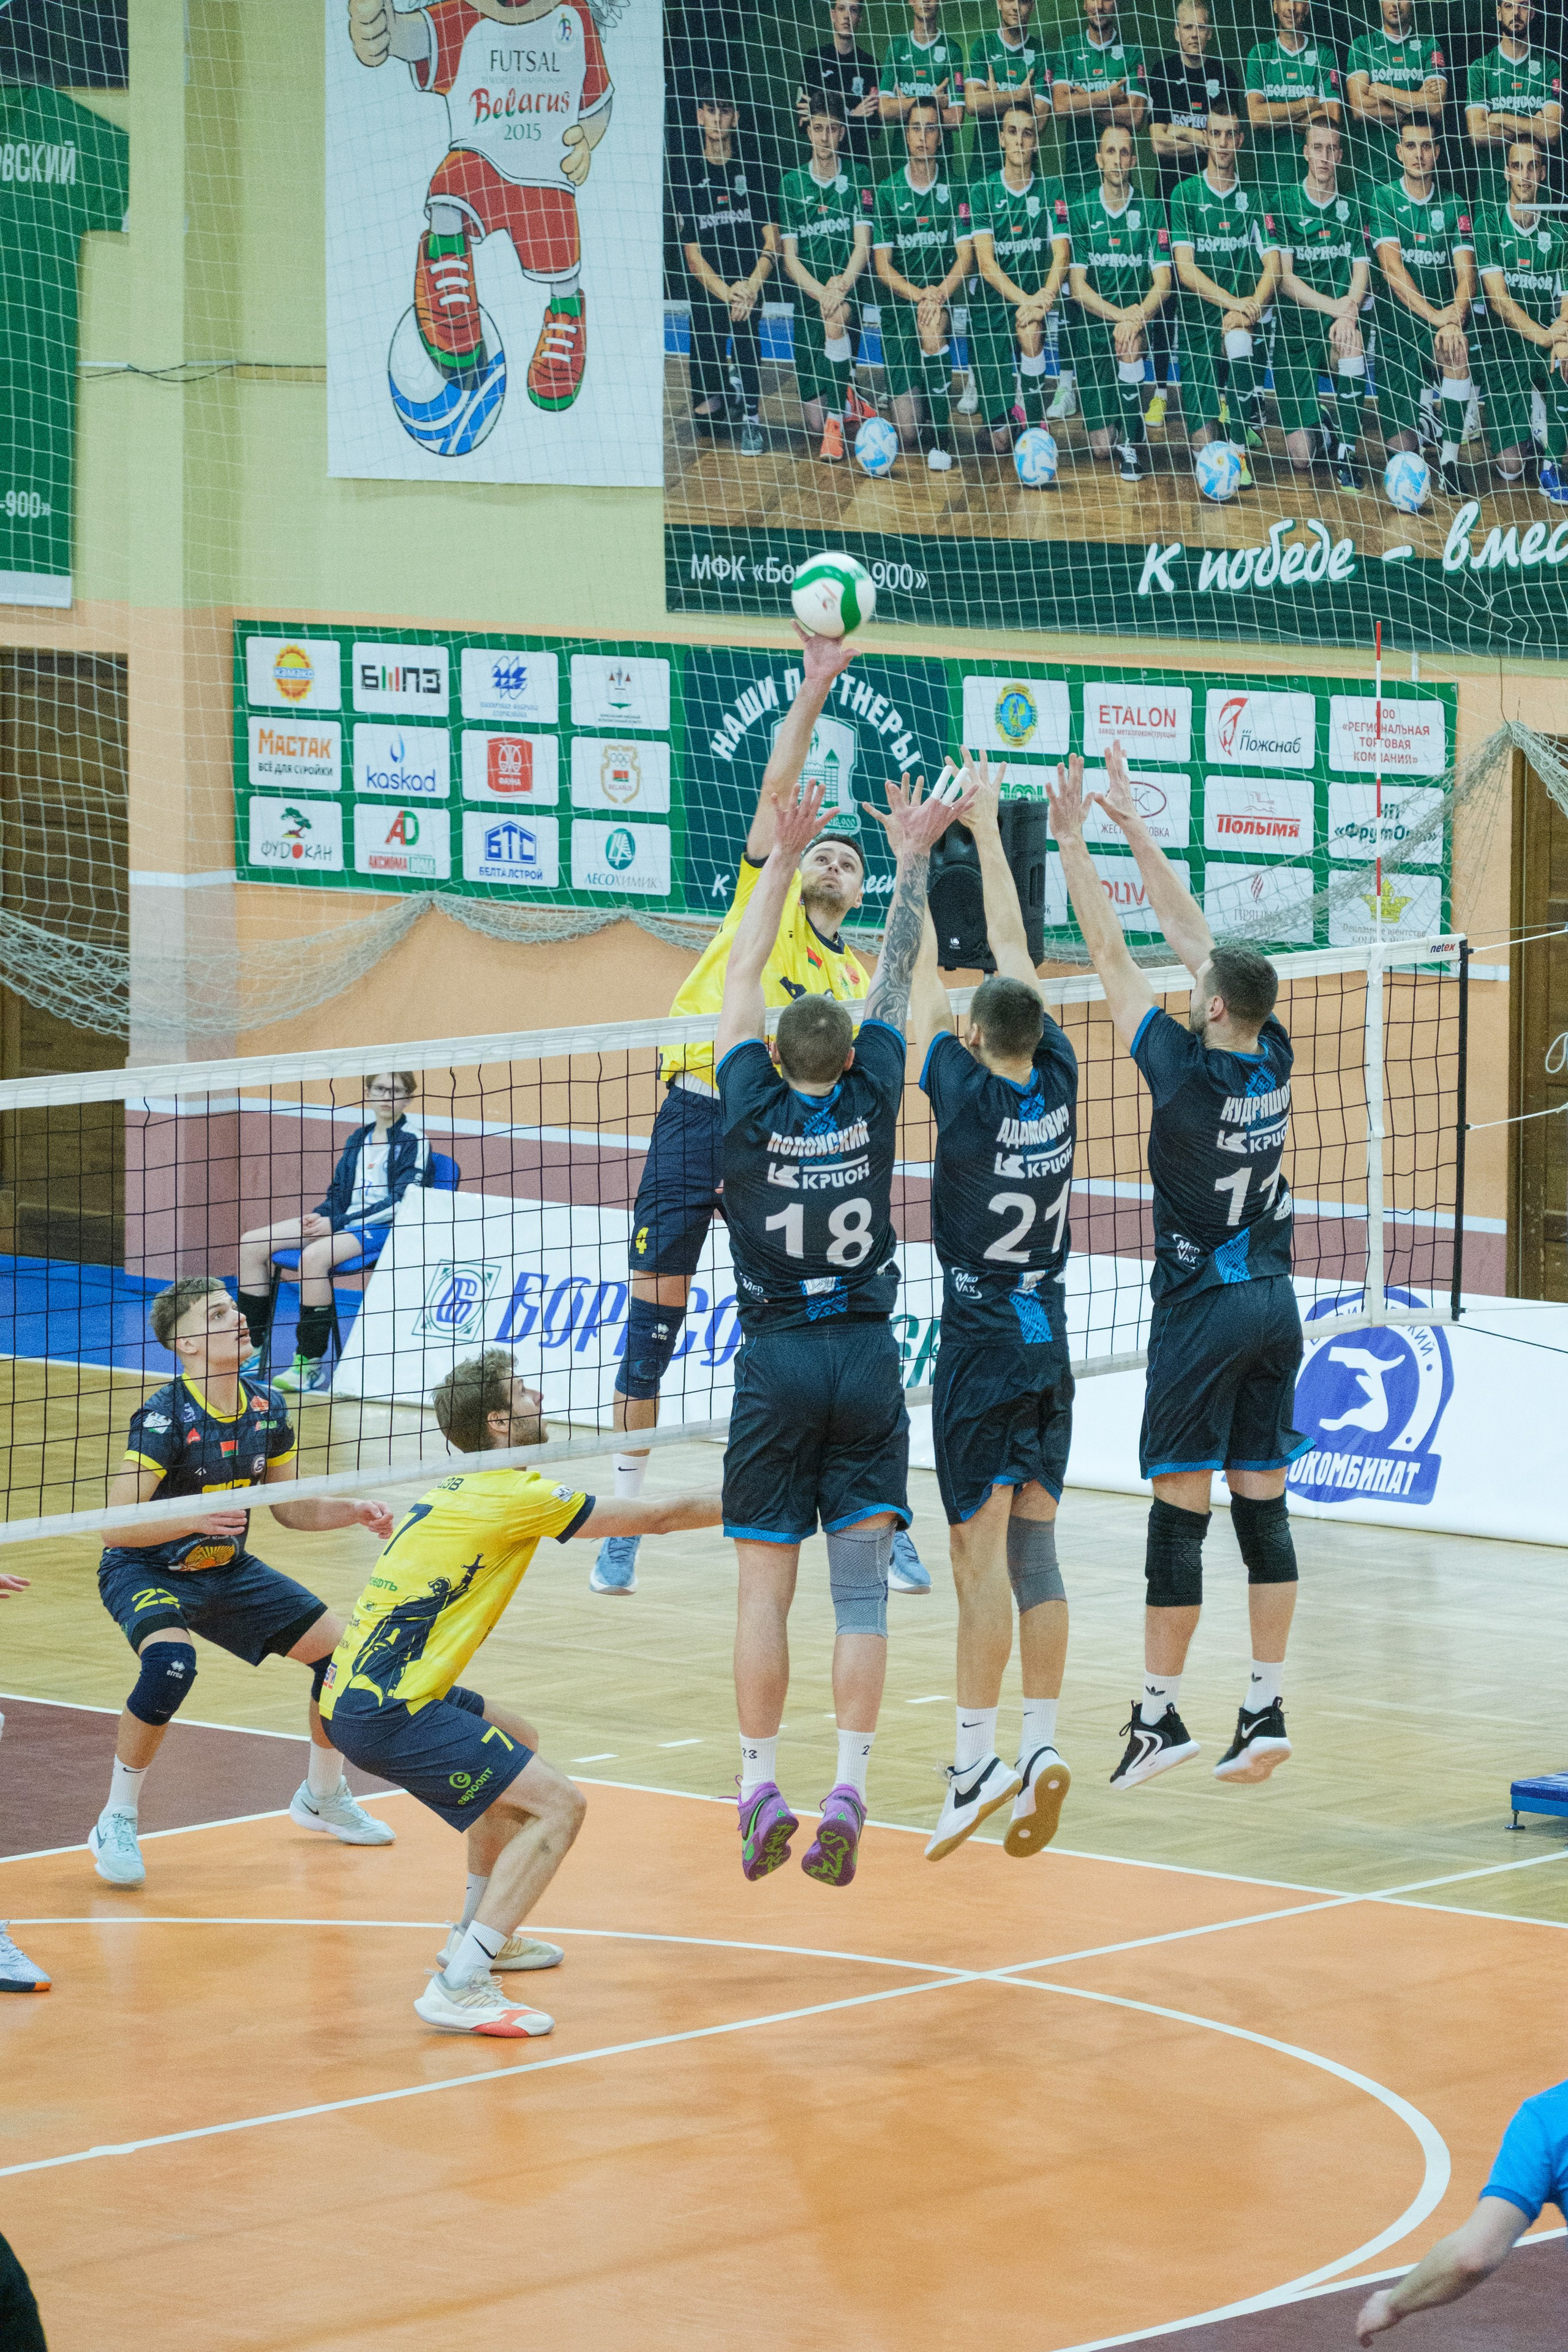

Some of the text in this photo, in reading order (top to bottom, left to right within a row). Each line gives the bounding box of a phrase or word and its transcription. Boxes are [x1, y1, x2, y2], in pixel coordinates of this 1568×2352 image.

[491, 50, 560, 72] FUTSAL
[469, 88, 570, 126] Belarus
[504, 123, 541, 141] 2015
[0, 140, 76, 186] ВСКИЙ
[691, 554, 746, 582] МФК
[1137, 542, 1183, 597] К
[1198, 519, 1357, 592] победе
[710, 668, 921, 772] НАШИ ПТНЕРЫ
[1099, 704, 1176, 728] ETALON
[1240, 734, 1301, 754] Пожснаб
[368, 765, 436, 792] kaskad
[487, 824, 535, 861] БТС
[479, 866, 543, 880] БЕЛТАЛСТРОЙ
[584, 872, 658, 889] ЛЕСОХИМИК
[712, 873, 731, 897] К
[1430, 943, 1456, 953] netex
[767, 1117, 870, 1158] ПОЛОНСКИЙ
[995, 1103, 1070, 1149] АДАМОВИЧ
[803, 1162, 870, 1190] КРИОН
[766, 1197, 875, 1268] 18
[984, 1178, 1072, 1264] 21
[635, 1227, 649, 1254] 4
[1177, 1250, 1197, 1264] VAX
[955, 1281, 976, 1294] VAX
[1288, 1452, 1421, 1495] ОКОМБИНАТ
[383, 1503, 434, 1556] 7
[131, 1588, 181, 1613] 22
[481, 1725, 514, 1752] 7
[458, 1767, 494, 1805] евроопт
